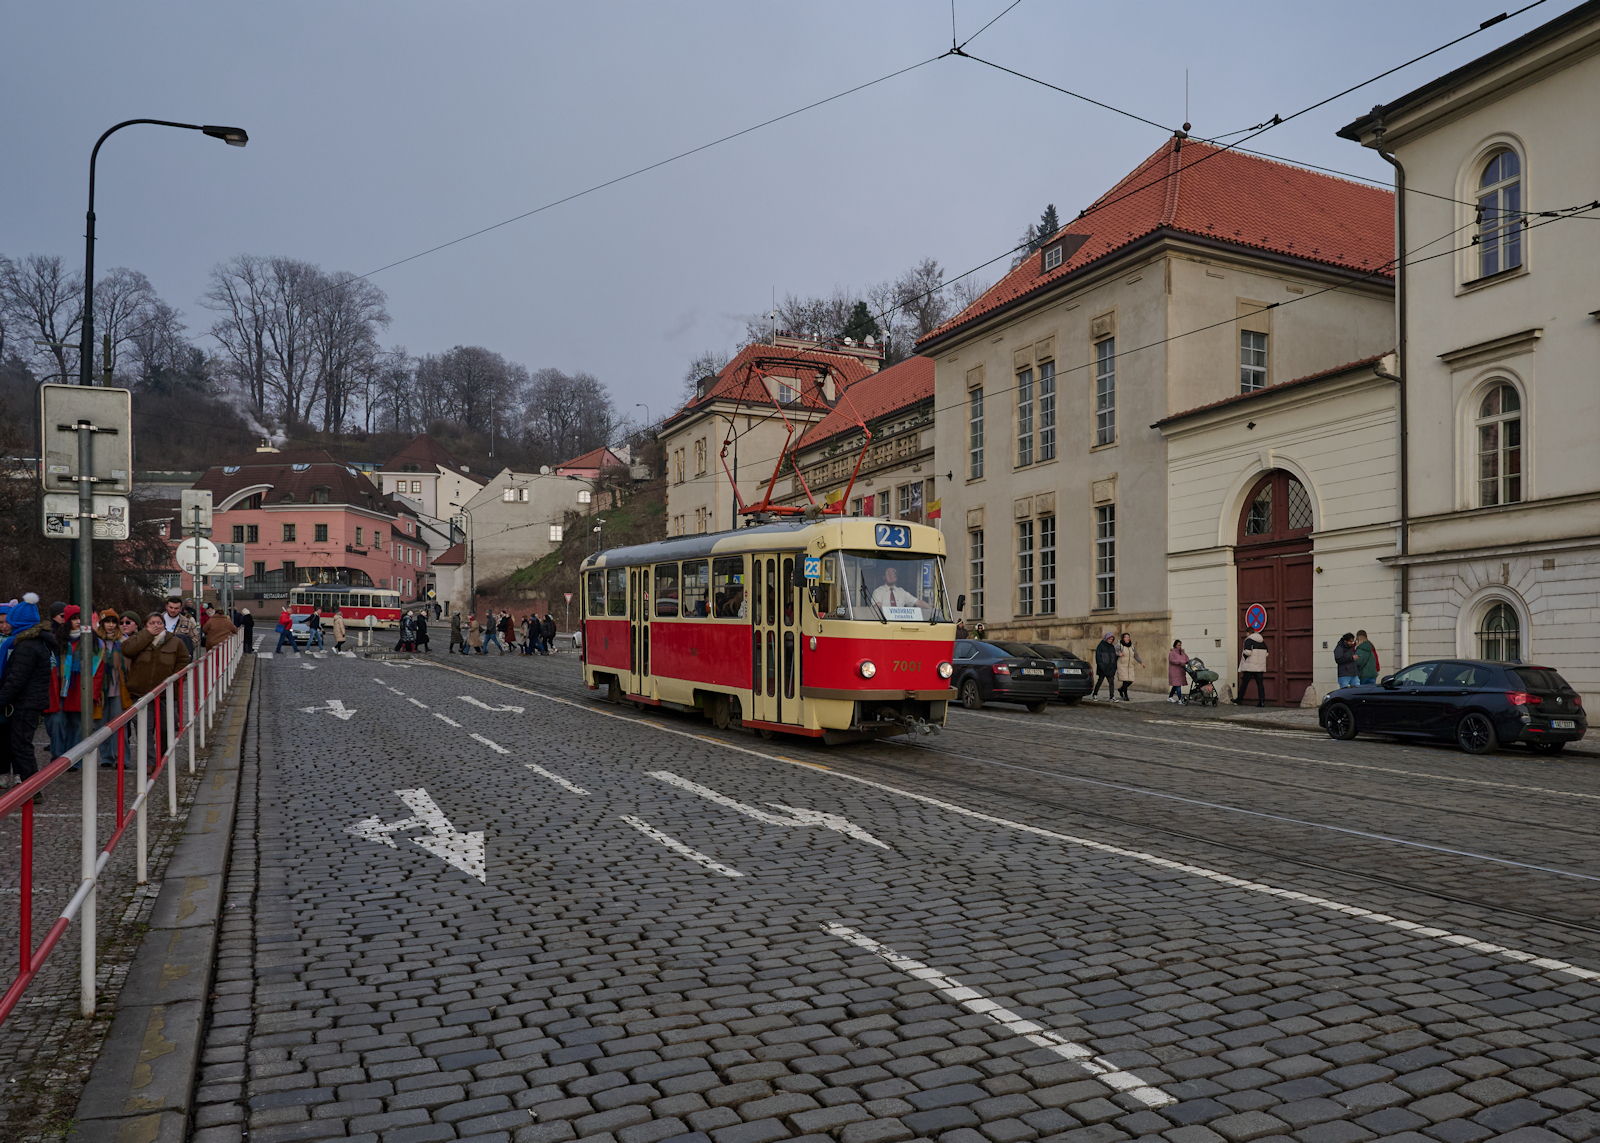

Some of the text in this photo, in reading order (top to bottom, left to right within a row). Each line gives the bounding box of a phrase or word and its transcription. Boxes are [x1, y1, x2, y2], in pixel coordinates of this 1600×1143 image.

[878, 525, 906, 546] 23
[805, 560, 820, 575] 23
[892, 660, 922, 672] 7001
